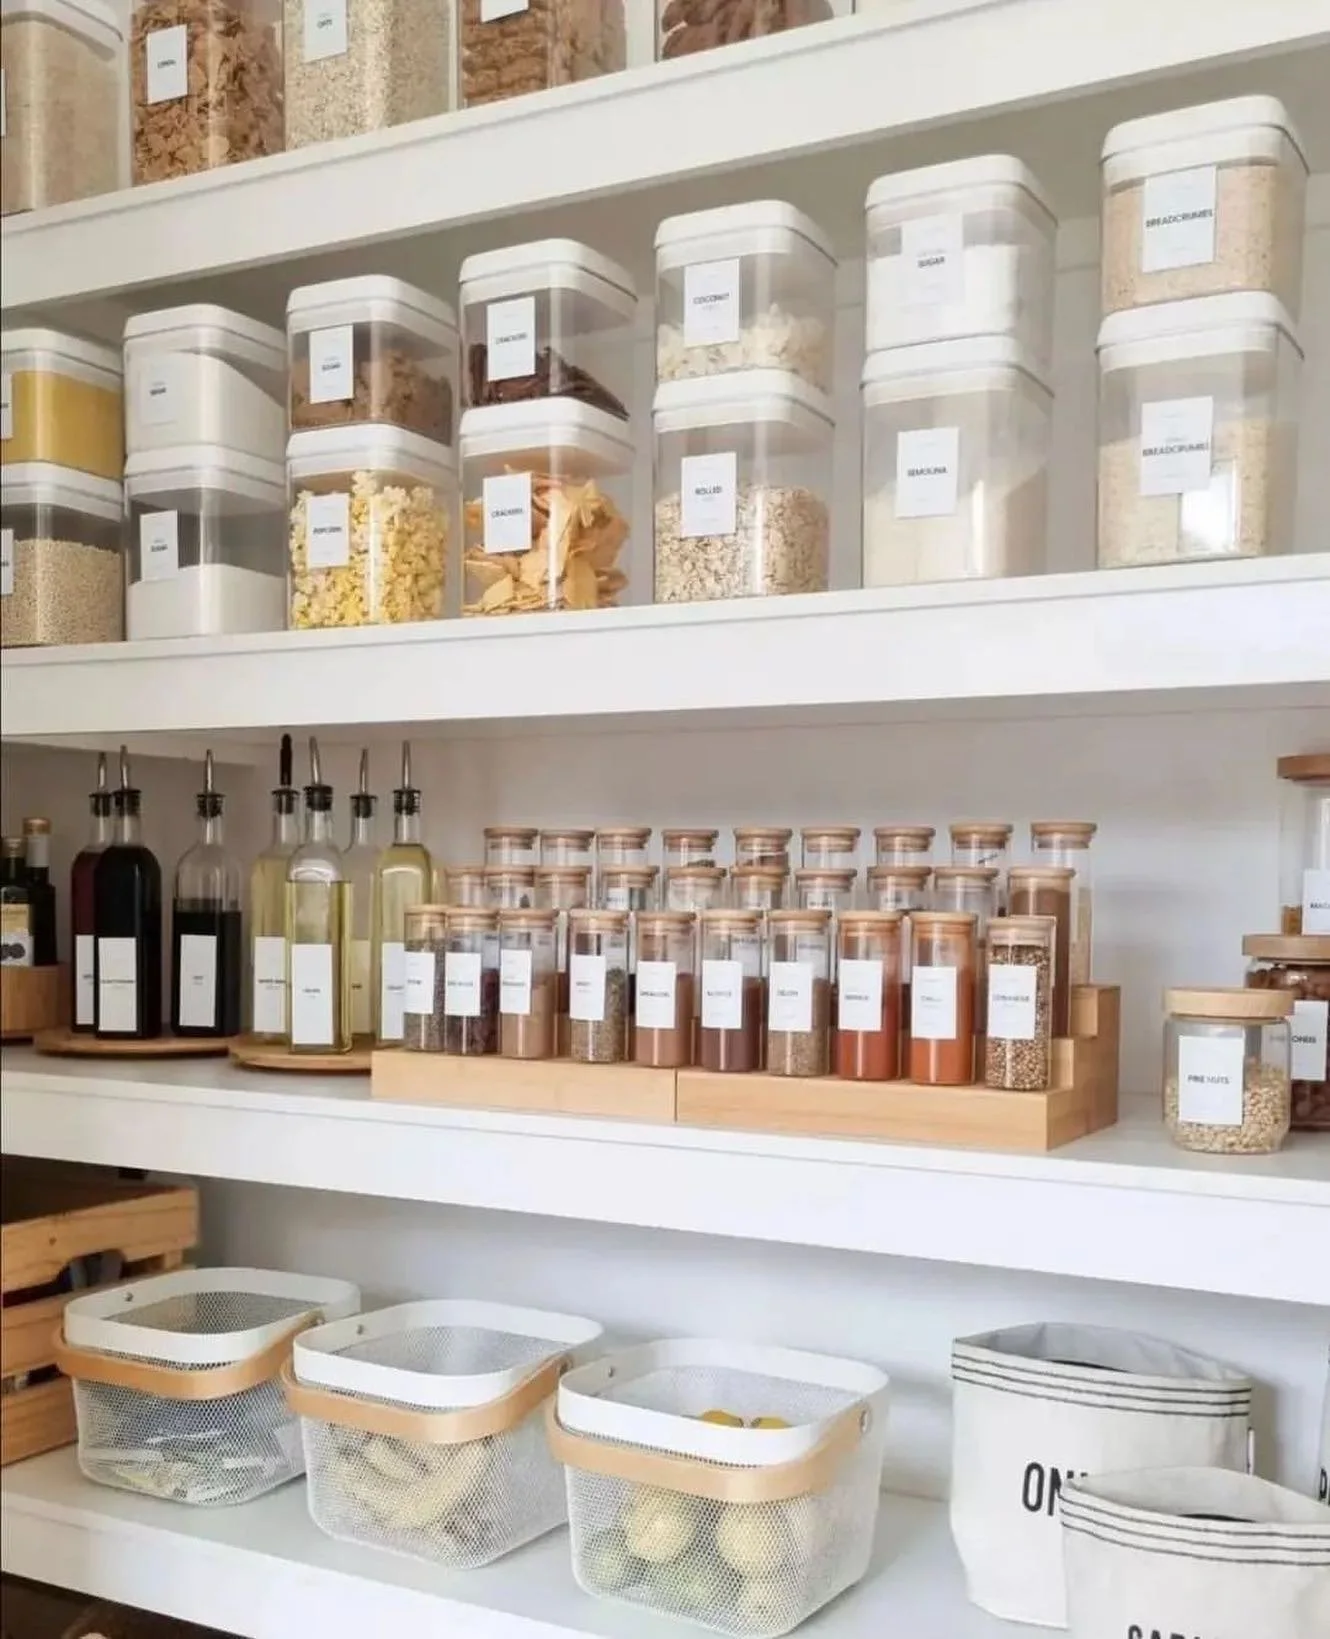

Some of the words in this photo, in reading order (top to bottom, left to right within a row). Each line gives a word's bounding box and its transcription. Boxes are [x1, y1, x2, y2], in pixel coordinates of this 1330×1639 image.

[1146, 208, 1213, 228] BREADCRUMBS
[918, 256, 945, 268] SUGAR
[1142, 442, 1209, 457] BREADCRUMBS
[908, 466, 948, 477] SEMOLINA
[695, 486, 723, 496] ROLLED
[1187, 1075, 1205, 1084] PINE
[1206, 1076, 1230, 1085] NUTS
